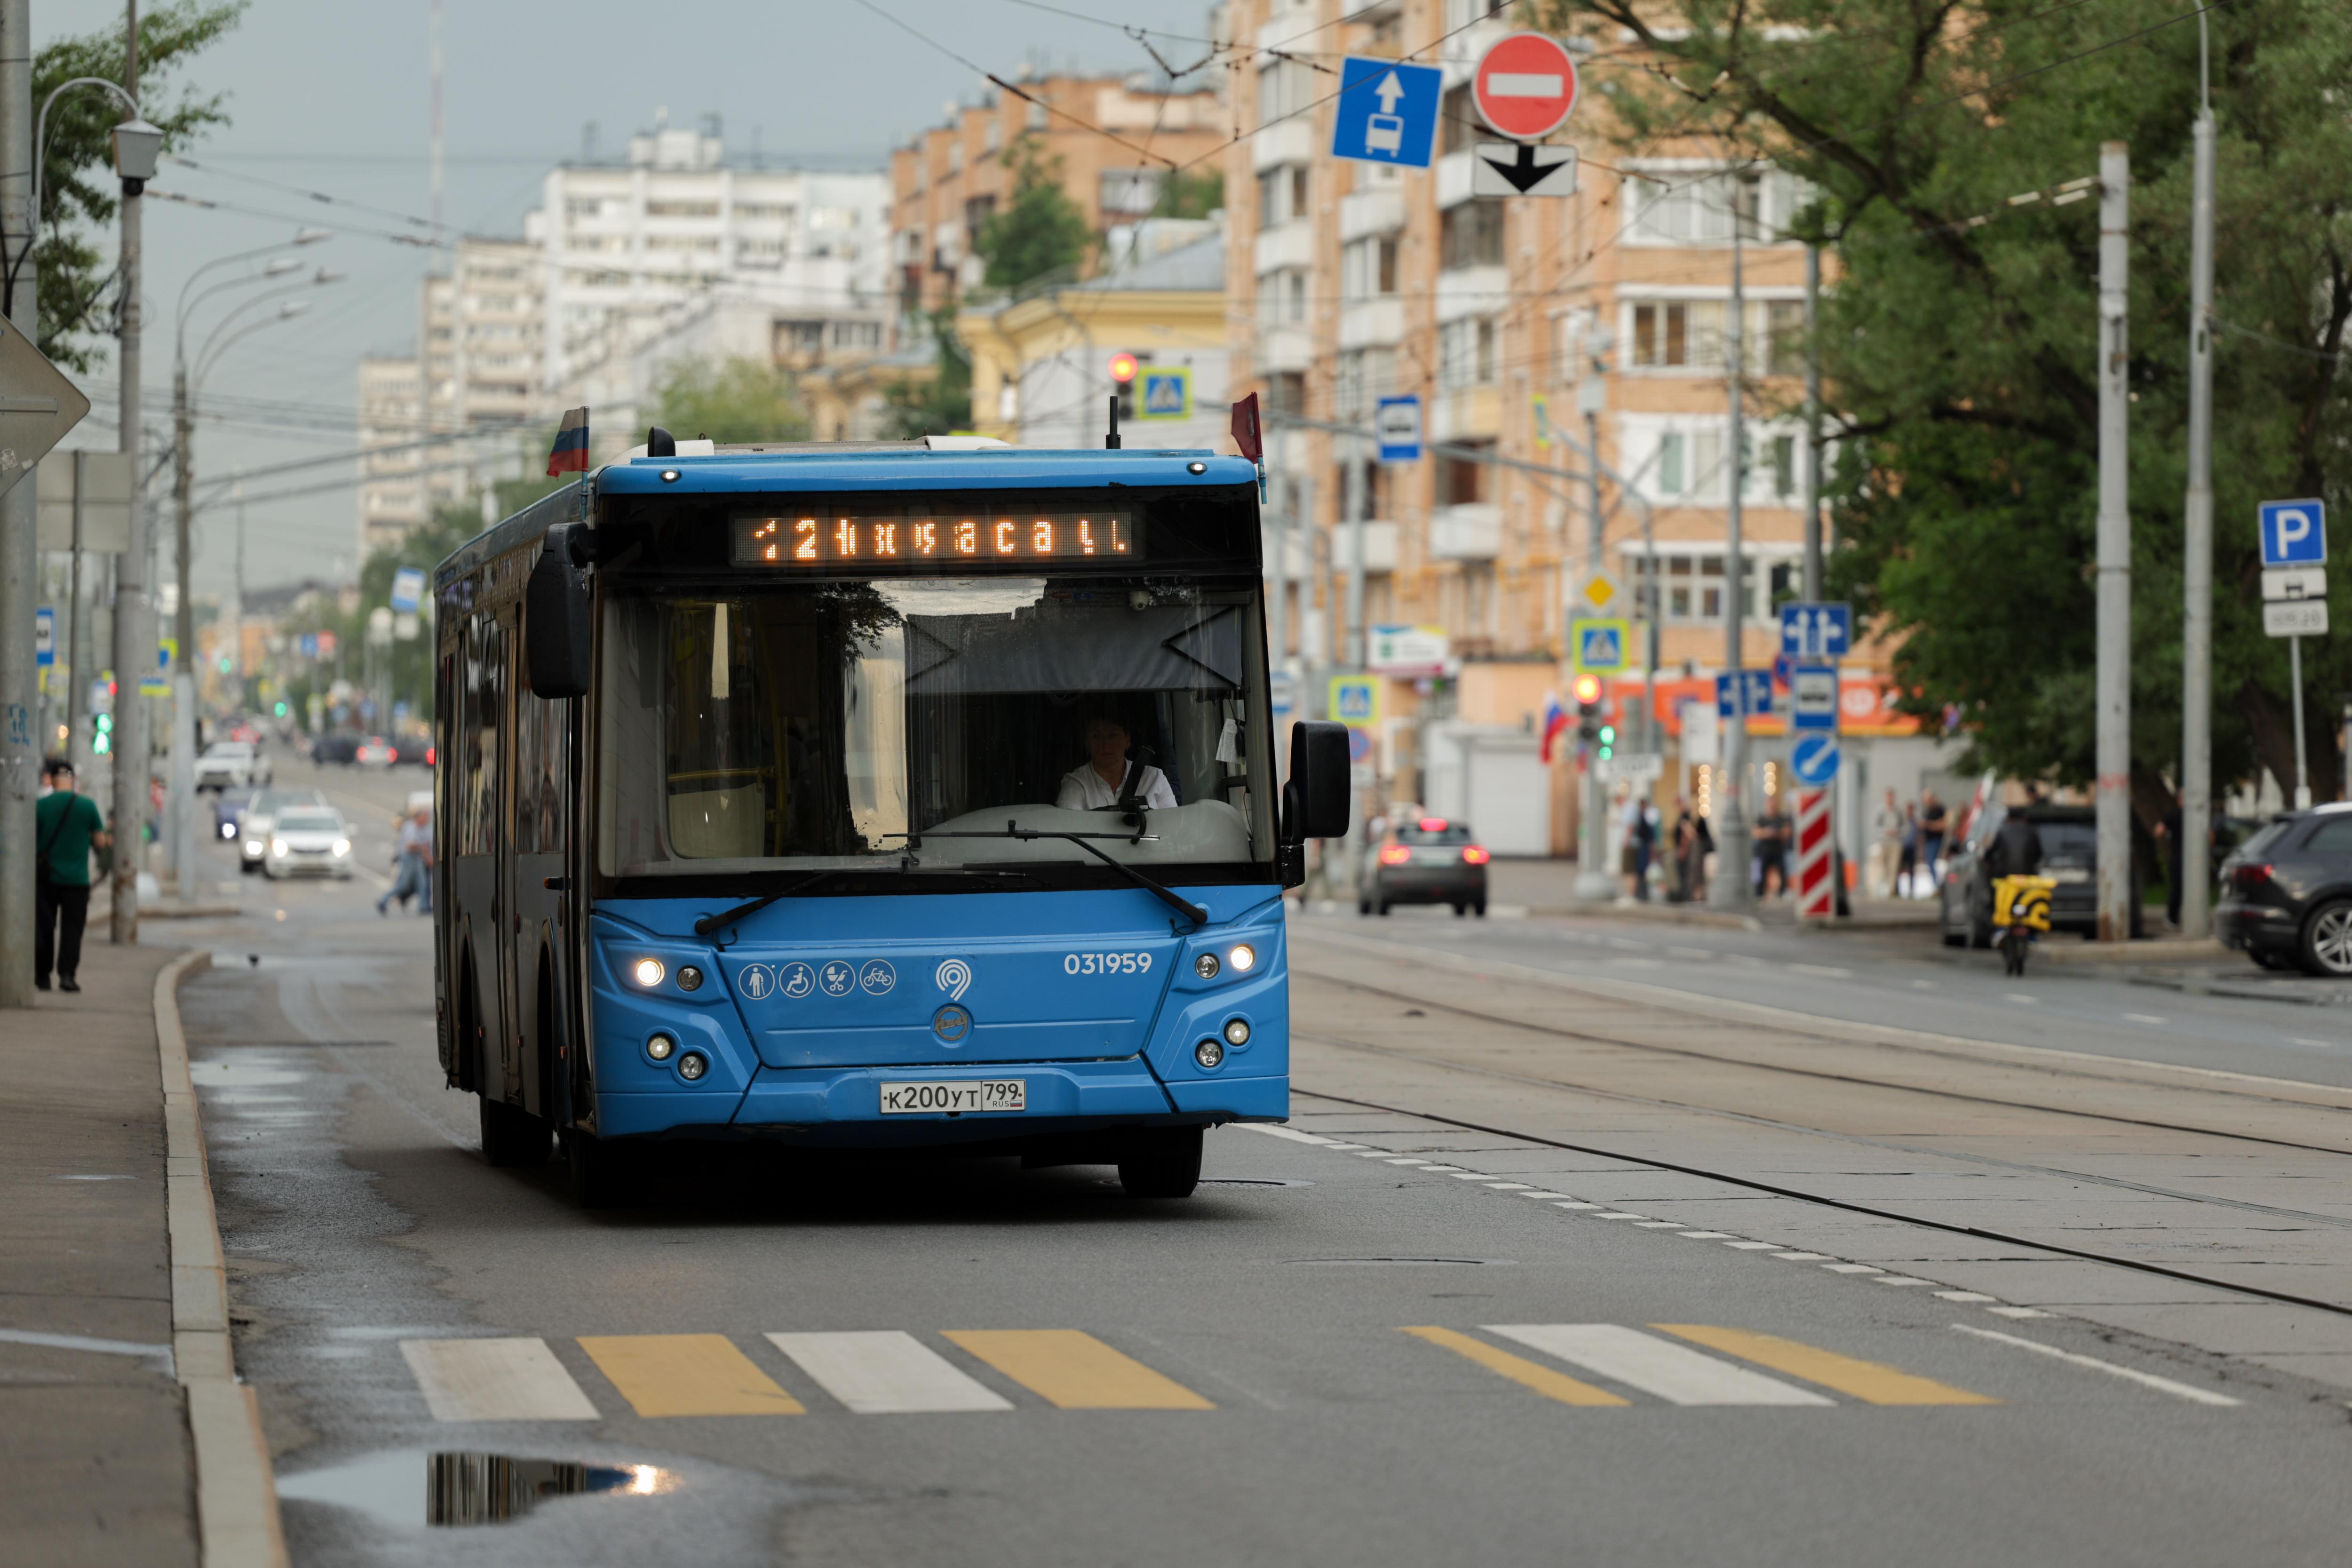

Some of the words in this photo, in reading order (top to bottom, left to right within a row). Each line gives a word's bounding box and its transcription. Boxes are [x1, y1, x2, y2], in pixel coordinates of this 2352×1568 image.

[2276, 509, 2311, 559] P
[1064, 952, 1152, 975] 031959
[889, 1086, 978, 1108] К200УТ
[984, 1083, 1019, 1100] 799
